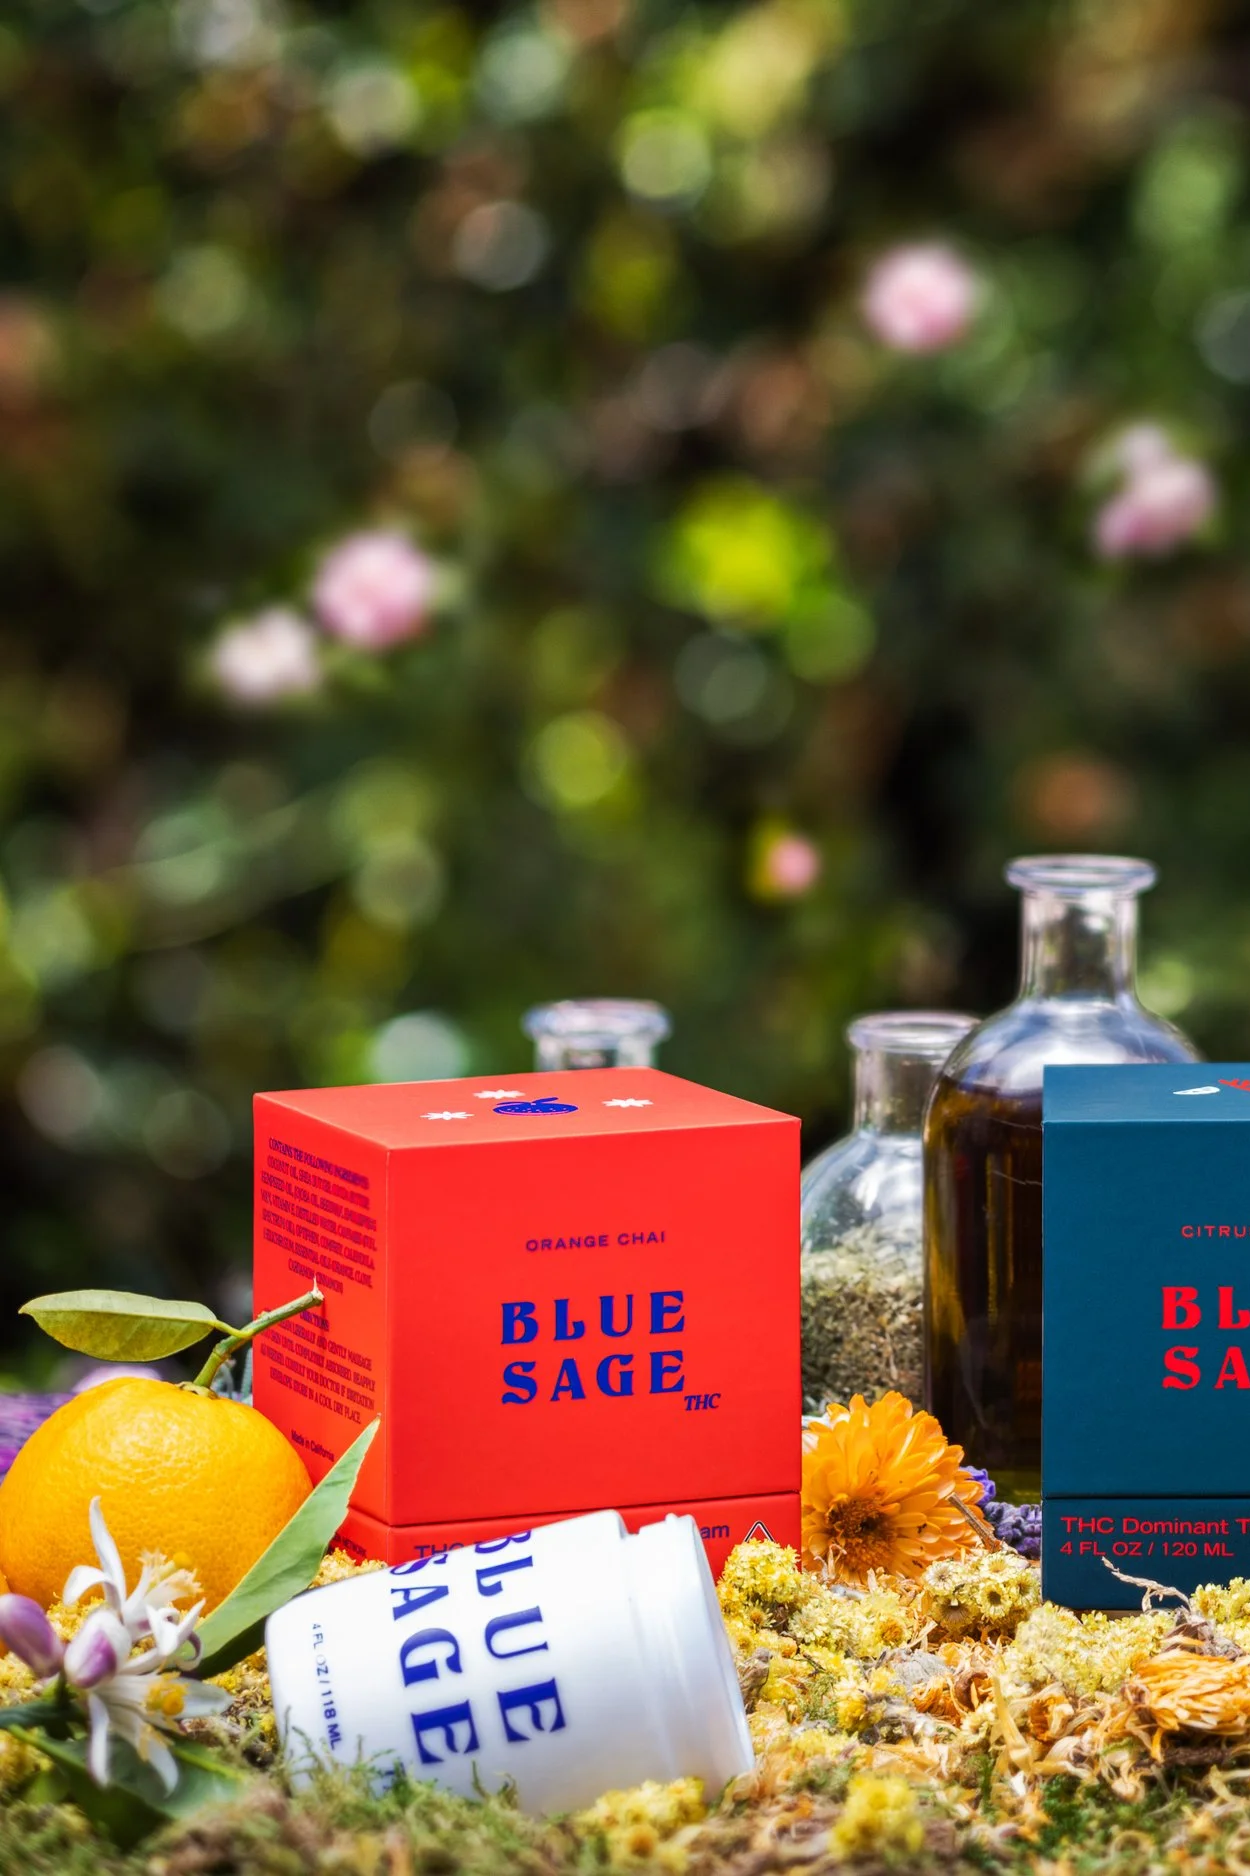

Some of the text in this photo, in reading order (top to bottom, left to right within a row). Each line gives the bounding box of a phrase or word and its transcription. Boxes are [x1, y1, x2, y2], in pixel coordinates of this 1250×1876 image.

[526, 1231, 666, 1252] ORANGE CHAI
[501, 1290, 685, 1345] BLUE
[501, 1349, 721, 1412] SAGE THC
[1060, 1517, 1115, 1534] THC
[1123, 1517, 1229, 1535] Dominant
[1060, 1541, 1234, 1557] 4 FL OZ / 120 ML
[311, 1622, 321, 1631] 4
[312, 1632, 324, 1650] FL
[315, 1654, 329, 1677] OZ
[321, 1689, 337, 1721] 118
[327, 1722, 342, 1751] ML
